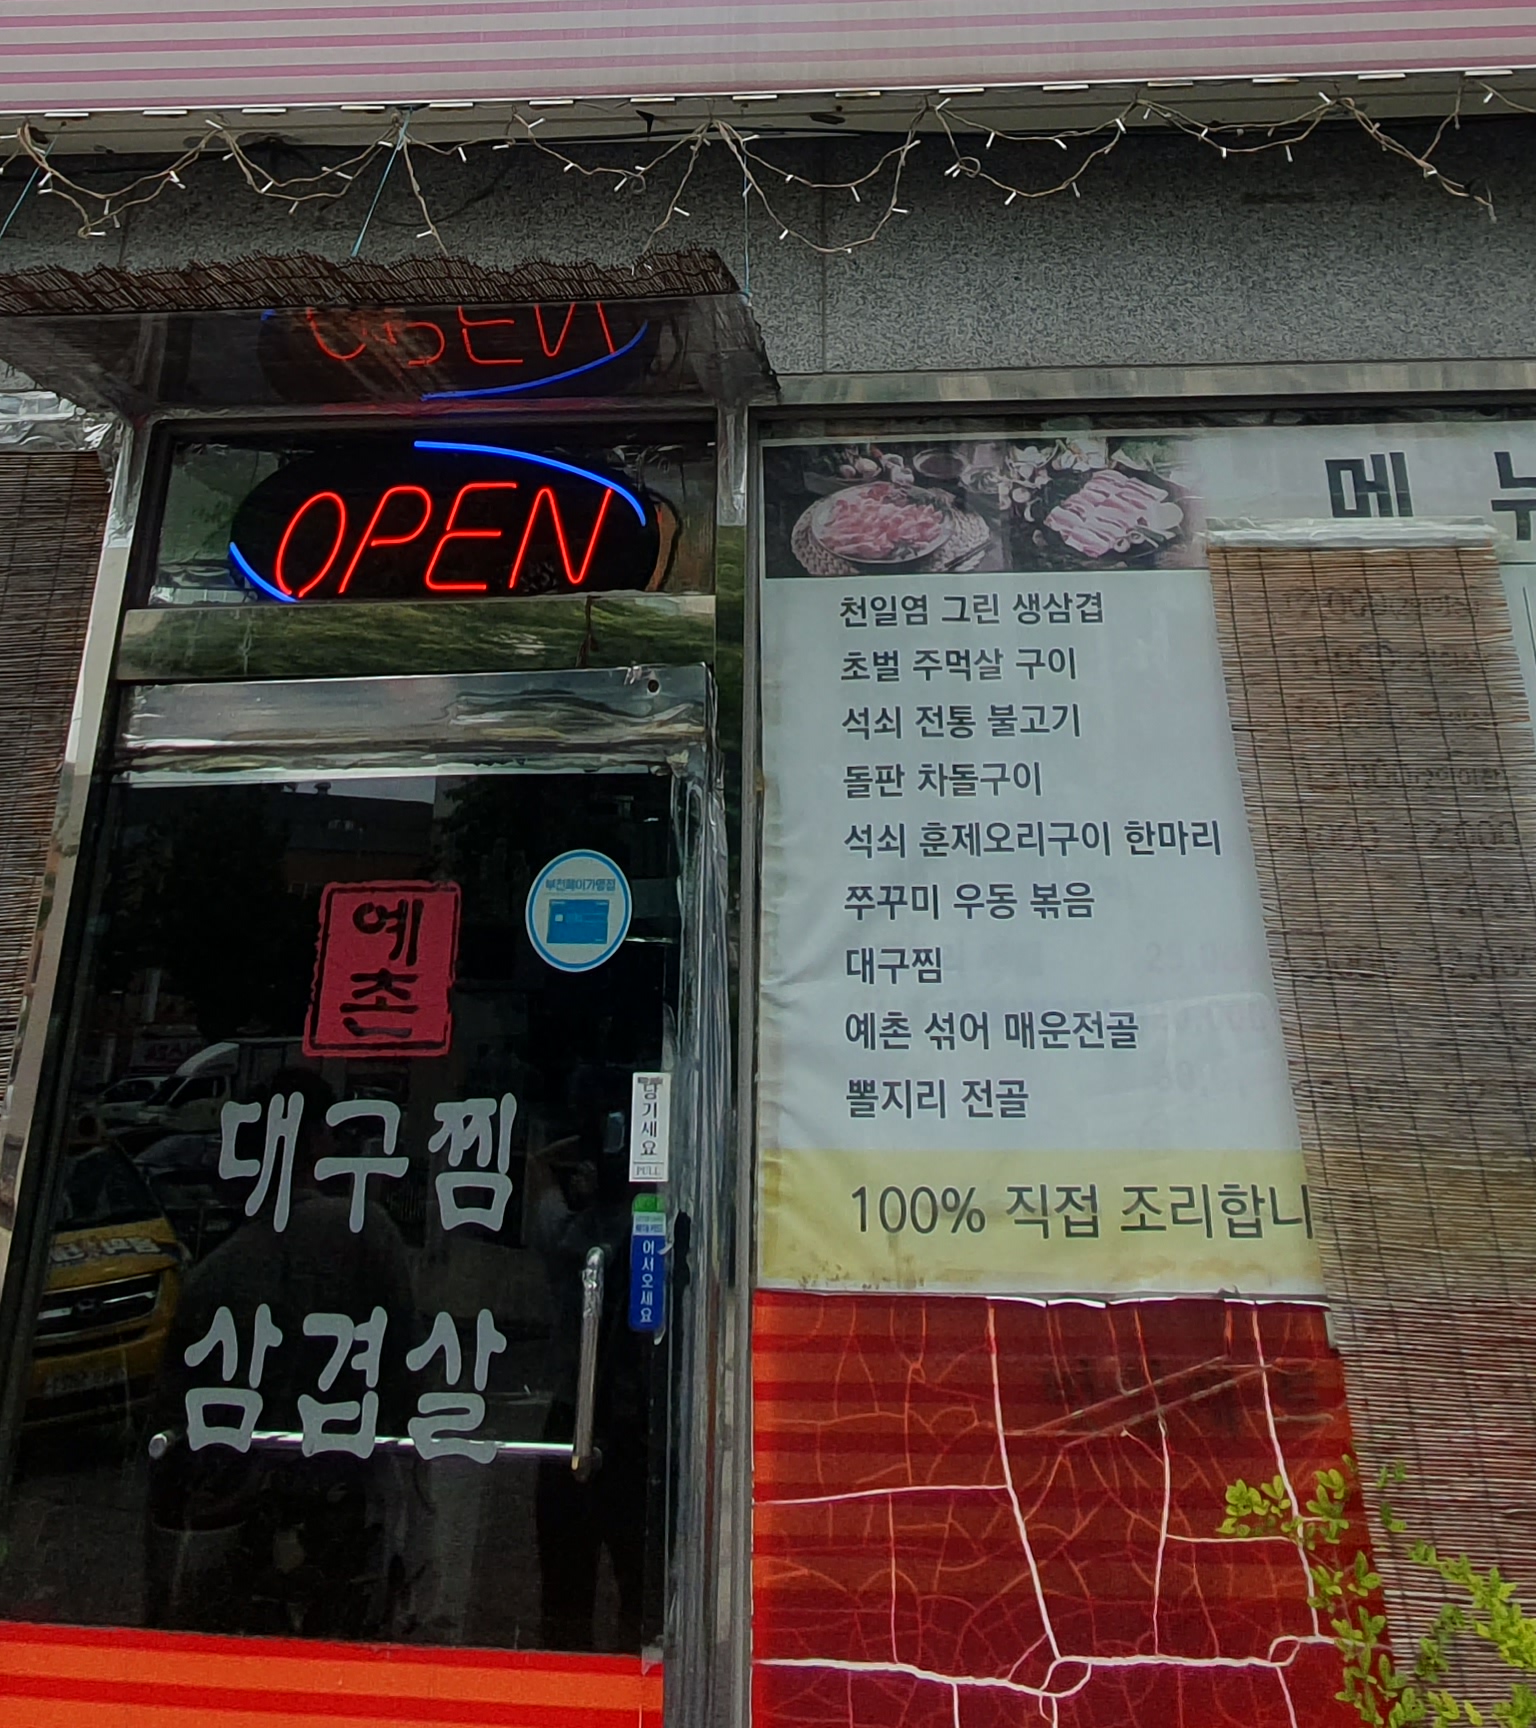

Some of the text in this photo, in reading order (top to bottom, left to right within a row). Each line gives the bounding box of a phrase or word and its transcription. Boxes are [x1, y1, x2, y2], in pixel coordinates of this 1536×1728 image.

[275, 481, 613, 599] OPEN
[839, 592, 1104, 628] 천일염 그린 생삼겹
[840, 647, 1078, 682] 초벌 주먹살 구이
[841, 704, 1082, 740] 석쇠 전통 불고기
[842, 762, 1043, 798] 돌판 차돌구이
[843, 819, 1222, 859] 석쇠 훈제오리구이 한마리
[843, 881, 1095, 921] 쭈꾸미 우동 볶음
[340, 896, 424, 1038] 예촌
[845, 947, 943, 985] 대구찜
[845, 1010, 1140, 1051] 예촌 섞어 매운전골
[845, 1079, 1029, 1119] 뽈지리 전골
[218, 1090, 518, 1234] 대구찜
[850, 1183, 1314, 1240] 100% 직접 조리합니
[183, 1302, 509, 1466] 삼겹살
